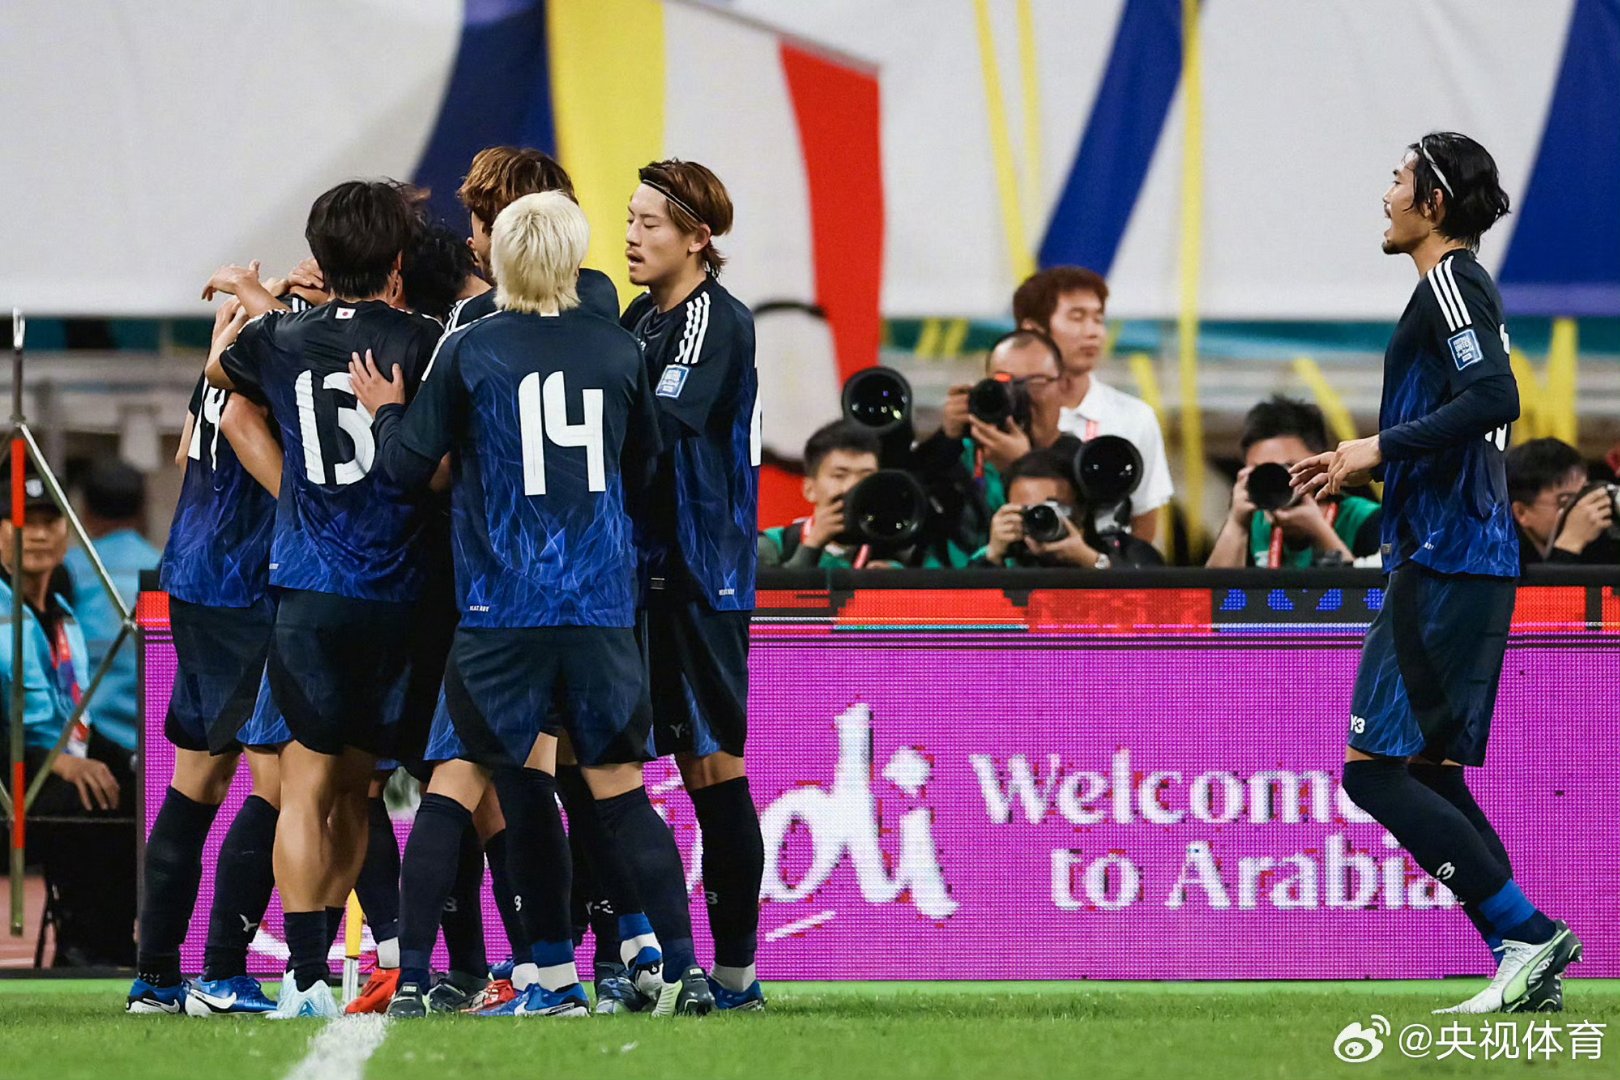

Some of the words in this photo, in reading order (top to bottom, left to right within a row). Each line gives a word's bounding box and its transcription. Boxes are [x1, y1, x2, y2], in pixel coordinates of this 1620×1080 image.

[294, 370, 376, 485] 13
[517, 370, 606, 496] 14
[1051, 847, 1141, 911] to
